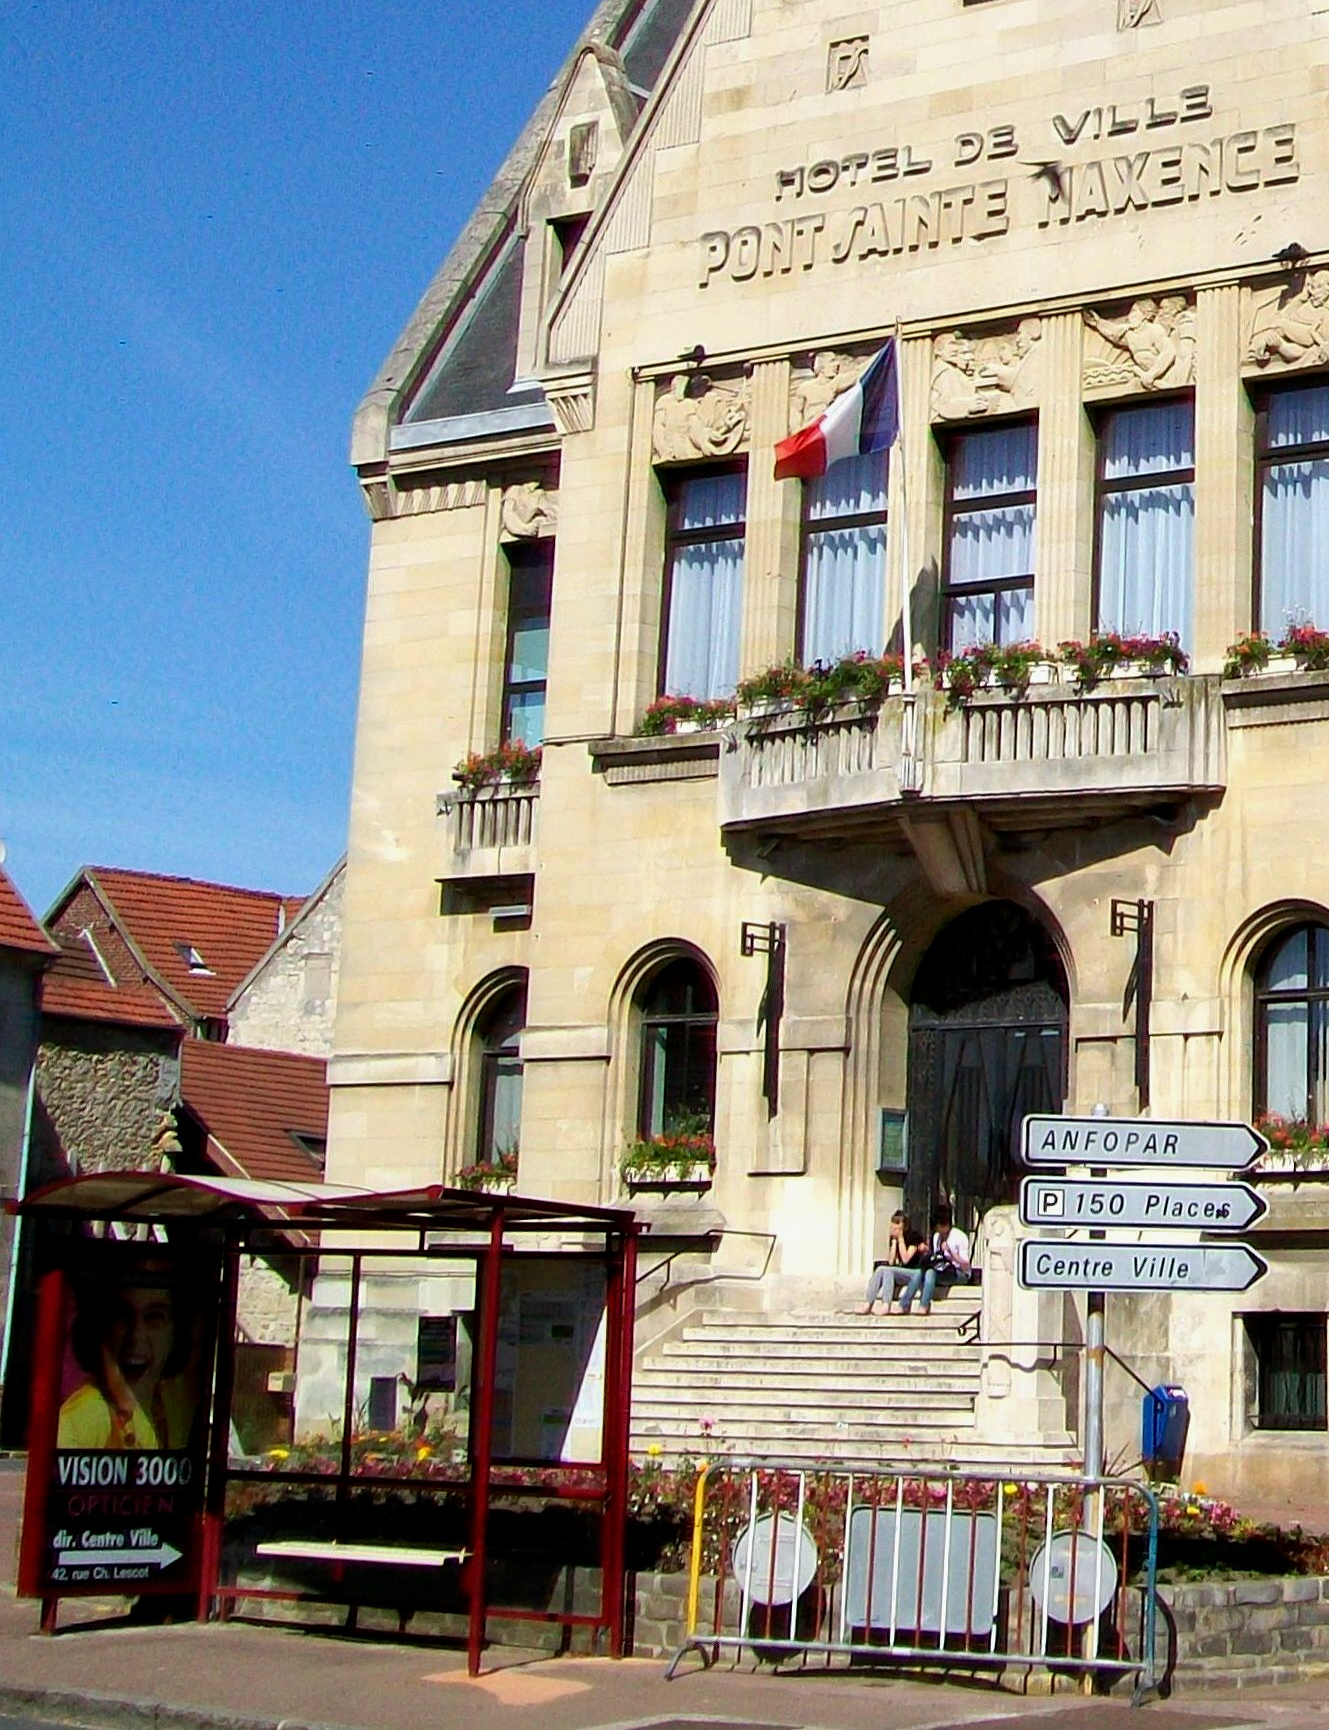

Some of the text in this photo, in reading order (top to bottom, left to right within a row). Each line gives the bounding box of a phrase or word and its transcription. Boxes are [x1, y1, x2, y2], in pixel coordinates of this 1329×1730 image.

[775, 84, 1213, 202] HOTEL DE VILLE
[699, 123, 1300, 289] PONT SAINTE MAXENCE
[1041, 1130, 1179, 1154] ANFOPAR
[1043, 1192, 1058, 1213] P
[1075, 1192, 1125, 1215] 150
[1036, 1253, 1189, 1278] Centre Ville
[58, 1456, 192, 1486] VISION 3000
[68, 1495, 174, 1516] OPTICIEN
[53, 1527, 159, 1548] dir. Centre Ville
[72, 1571, 90, 1580] rue
